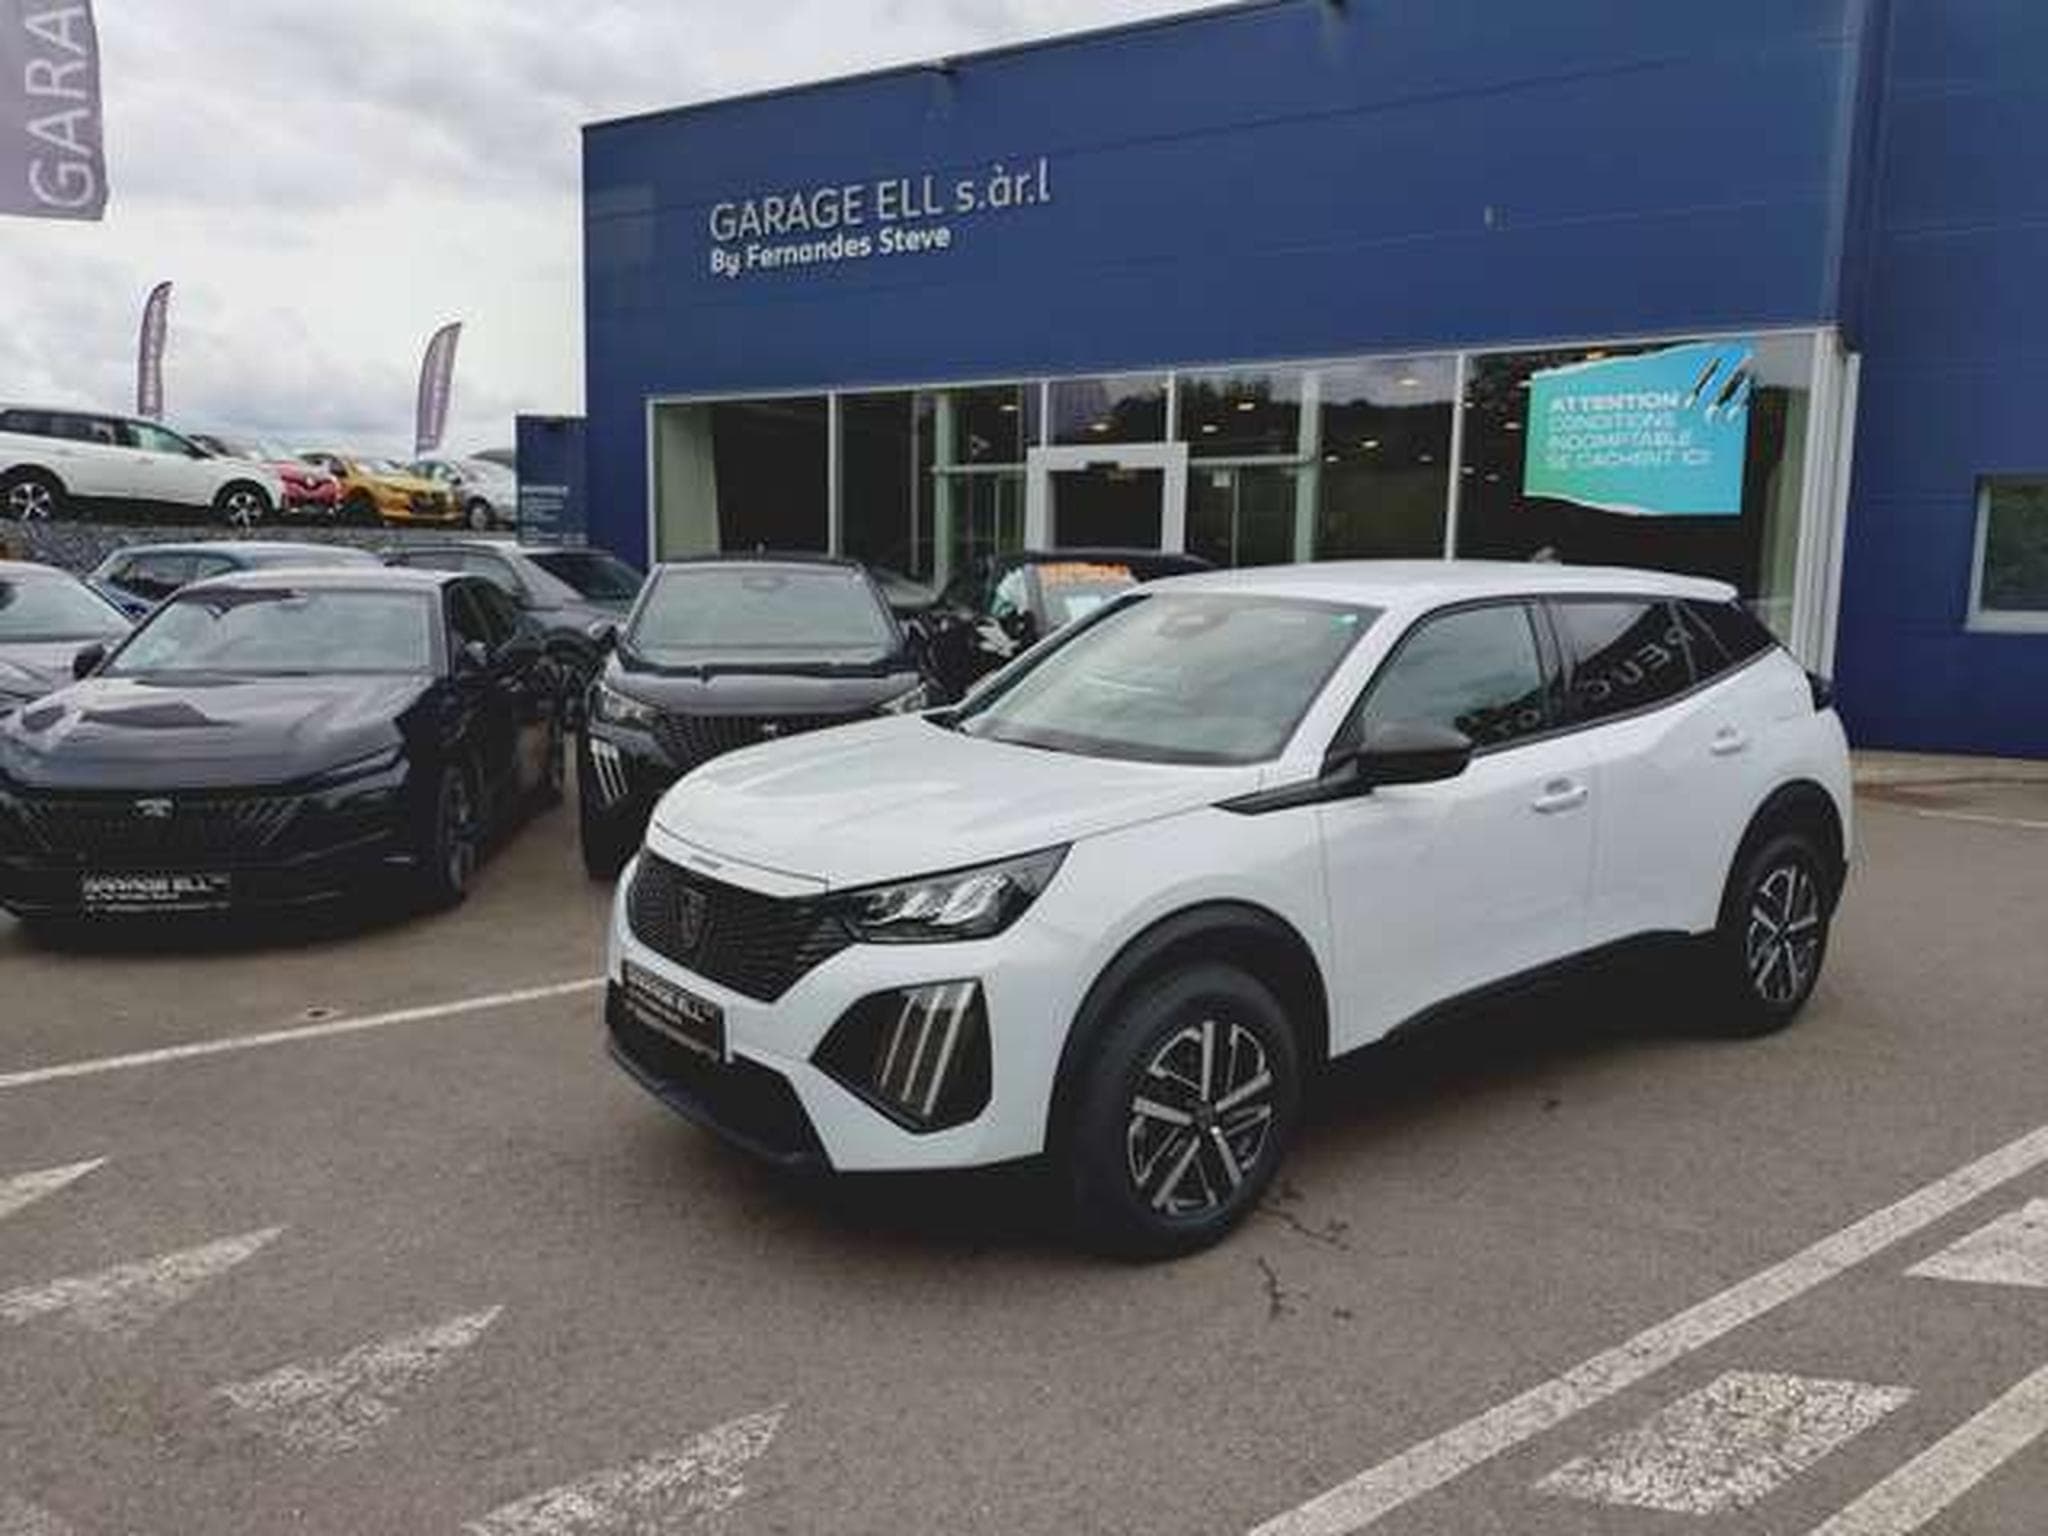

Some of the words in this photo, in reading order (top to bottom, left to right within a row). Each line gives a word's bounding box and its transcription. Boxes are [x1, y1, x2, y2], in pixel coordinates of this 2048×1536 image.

[709, 184, 866, 241] GARAGE
[878, 175, 945, 221] ELL
[711, 247, 741, 278] By
[746, 234, 872, 269] Fernandes
[879, 225, 952, 255] Steve
[1550, 390, 1681, 413] ATTENTION
